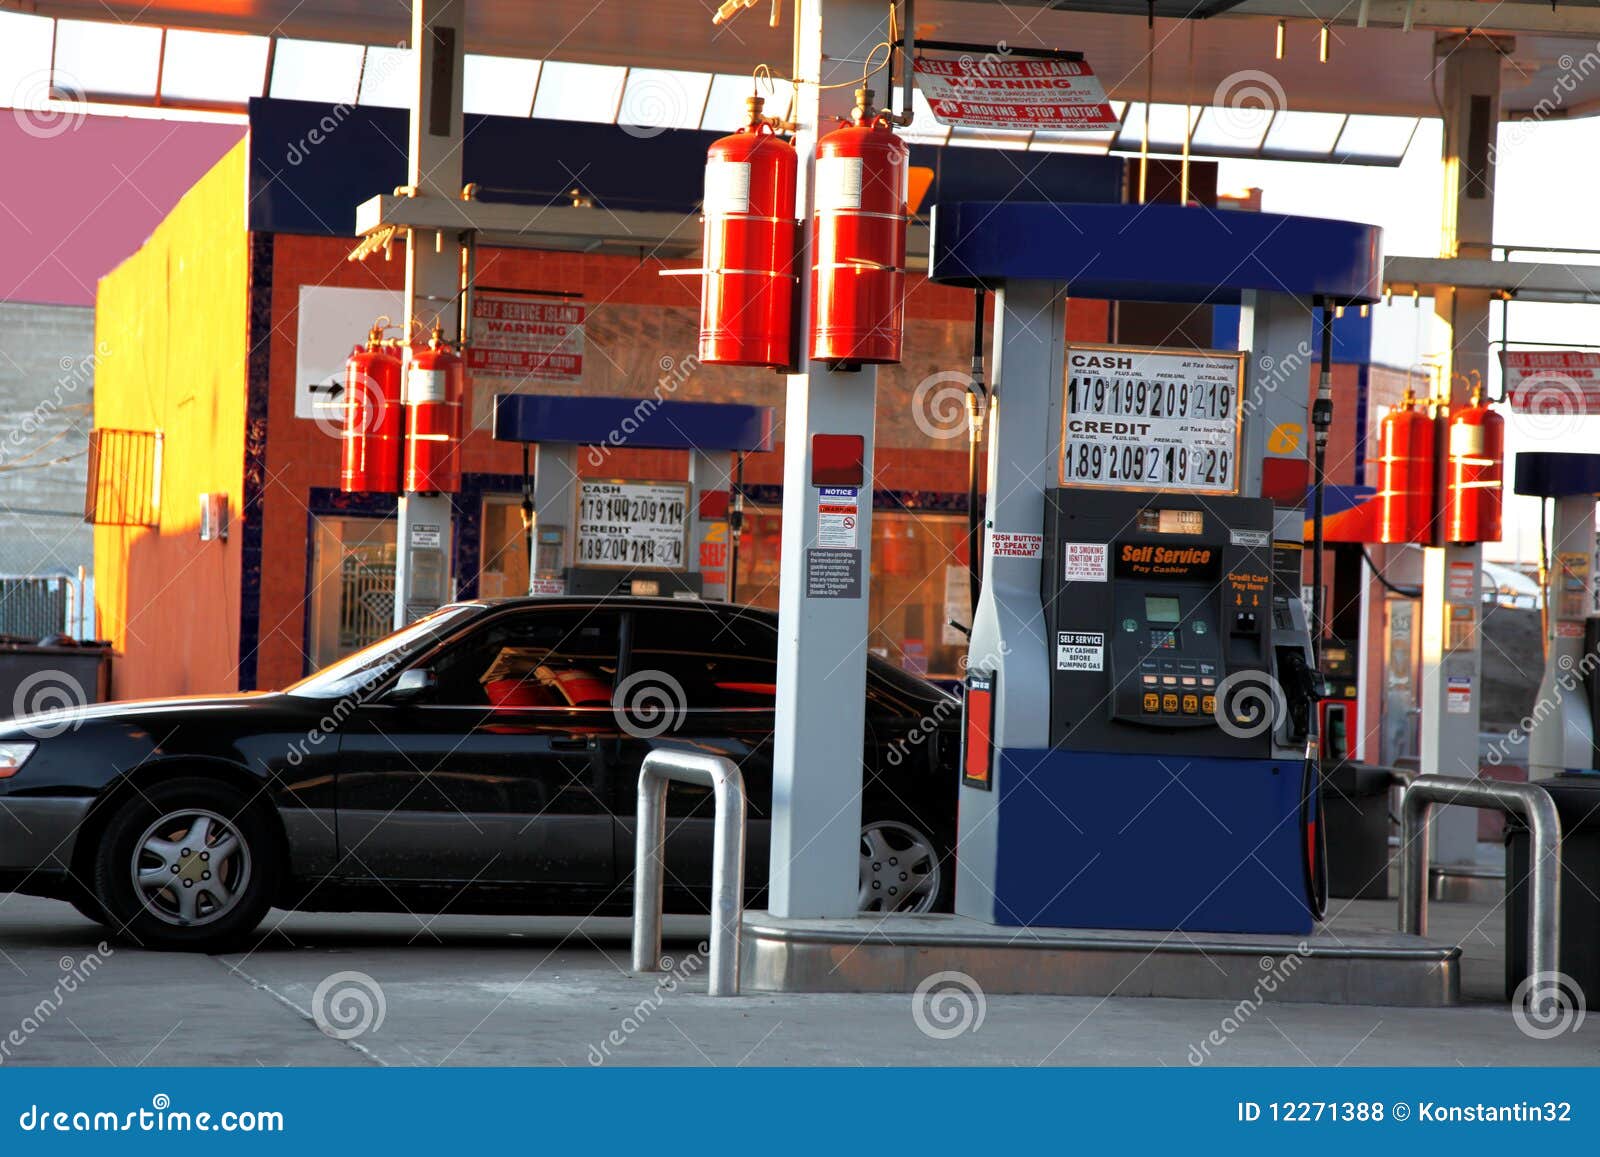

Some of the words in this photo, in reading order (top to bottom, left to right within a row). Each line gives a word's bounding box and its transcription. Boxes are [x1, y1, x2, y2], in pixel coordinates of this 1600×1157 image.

[921, 60, 953, 74] SELF
[1029, 61, 1080, 76] ISLAND
[943, 77, 1071, 89] WARNING
[963, 103, 1016, 117] SMOKING
[1027, 105, 1055, 117] STOP
[1061, 107, 1103, 117] MOTOR
[476, 300, 498, 317] SELF
[501, 302, 541, 320] SERVICE
[544, 305, 579, 322] ISLAND
[487, 321, 567, 336] WARNING
[1071, 355, 1133, 370] CASH
[1181, 361, 1190, 369] All
[1191, 362, 1204, 370] Tax
[1205, 362, 1235, 370] Included
[1068, 420, 1151, 436] CREDIT
[1267, 422, 1304, 455] 6
[582, 485, 621, 494] CASH
[825, 488, 852, 496] NOTICE
[580, 525, 632, 534] CREDIT
[704, 522, 729, 542] 2
[1013, 535, 1042, 543] BUTTON
[699, 543, 727, 567] SELF
[994, 548, 1036, 557] ATTENDANT
[1079, 546, 1104, 554] SMOKING
[1122, 545, 1153, 563] Self
[1155, 547, 1211, 564] Service
[1069, 554, 1092, 563] IGNITION
[1094, 555, 1104, 563] OFF
[1133, 565, 1150, 573] Pay
[1228, 572, 1251, 582] Credit
[1252, 574, 1269, 583] Card
[1232, 582, 1247, 591] Pay
[1248, 583, 1264, 591] Here
[1060, 635, 1075, 644] SELF
[1076, 636, 1102, 645] SERVICE
[1075, 647, 1098, 655] CASHIER
[1059, 661, 1087, 669] PUMPING
[1088, 662, 1101, 670] GAS
[1146, 698, 1157, 708] 87
[1165, 699, 1176, 708] 89
[1184, 699, 1196, 709] 91
